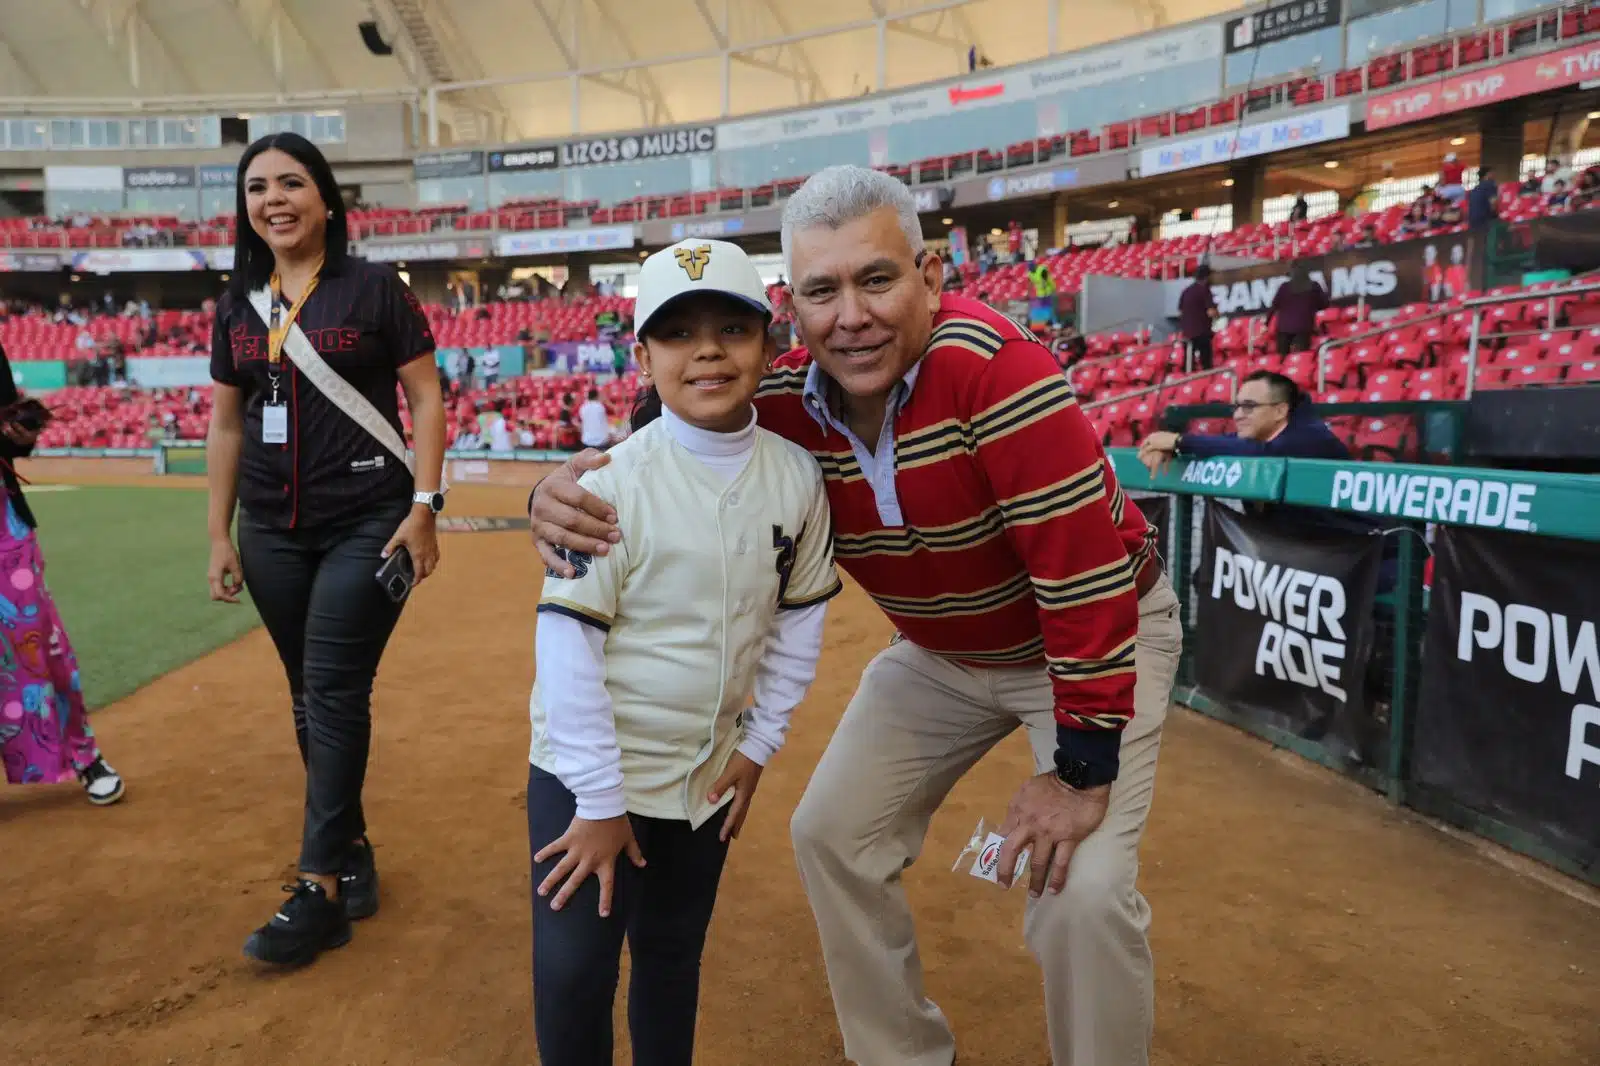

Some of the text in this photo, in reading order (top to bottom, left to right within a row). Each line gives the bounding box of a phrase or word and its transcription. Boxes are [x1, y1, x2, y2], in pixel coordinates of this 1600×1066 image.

[1461, 74, 1505, 101] TVP
[563, 138, 619, 165] LIZOS
[642, 127, 713, 156] MUSIC
[1159, 118, 1325, 166] Mobil Mobil Mobil
[1330, 469, 1537, 532] POWERADE
[1211, 546, 1347, 641] POWER
[1255, 621, 1347, 703] ADE
